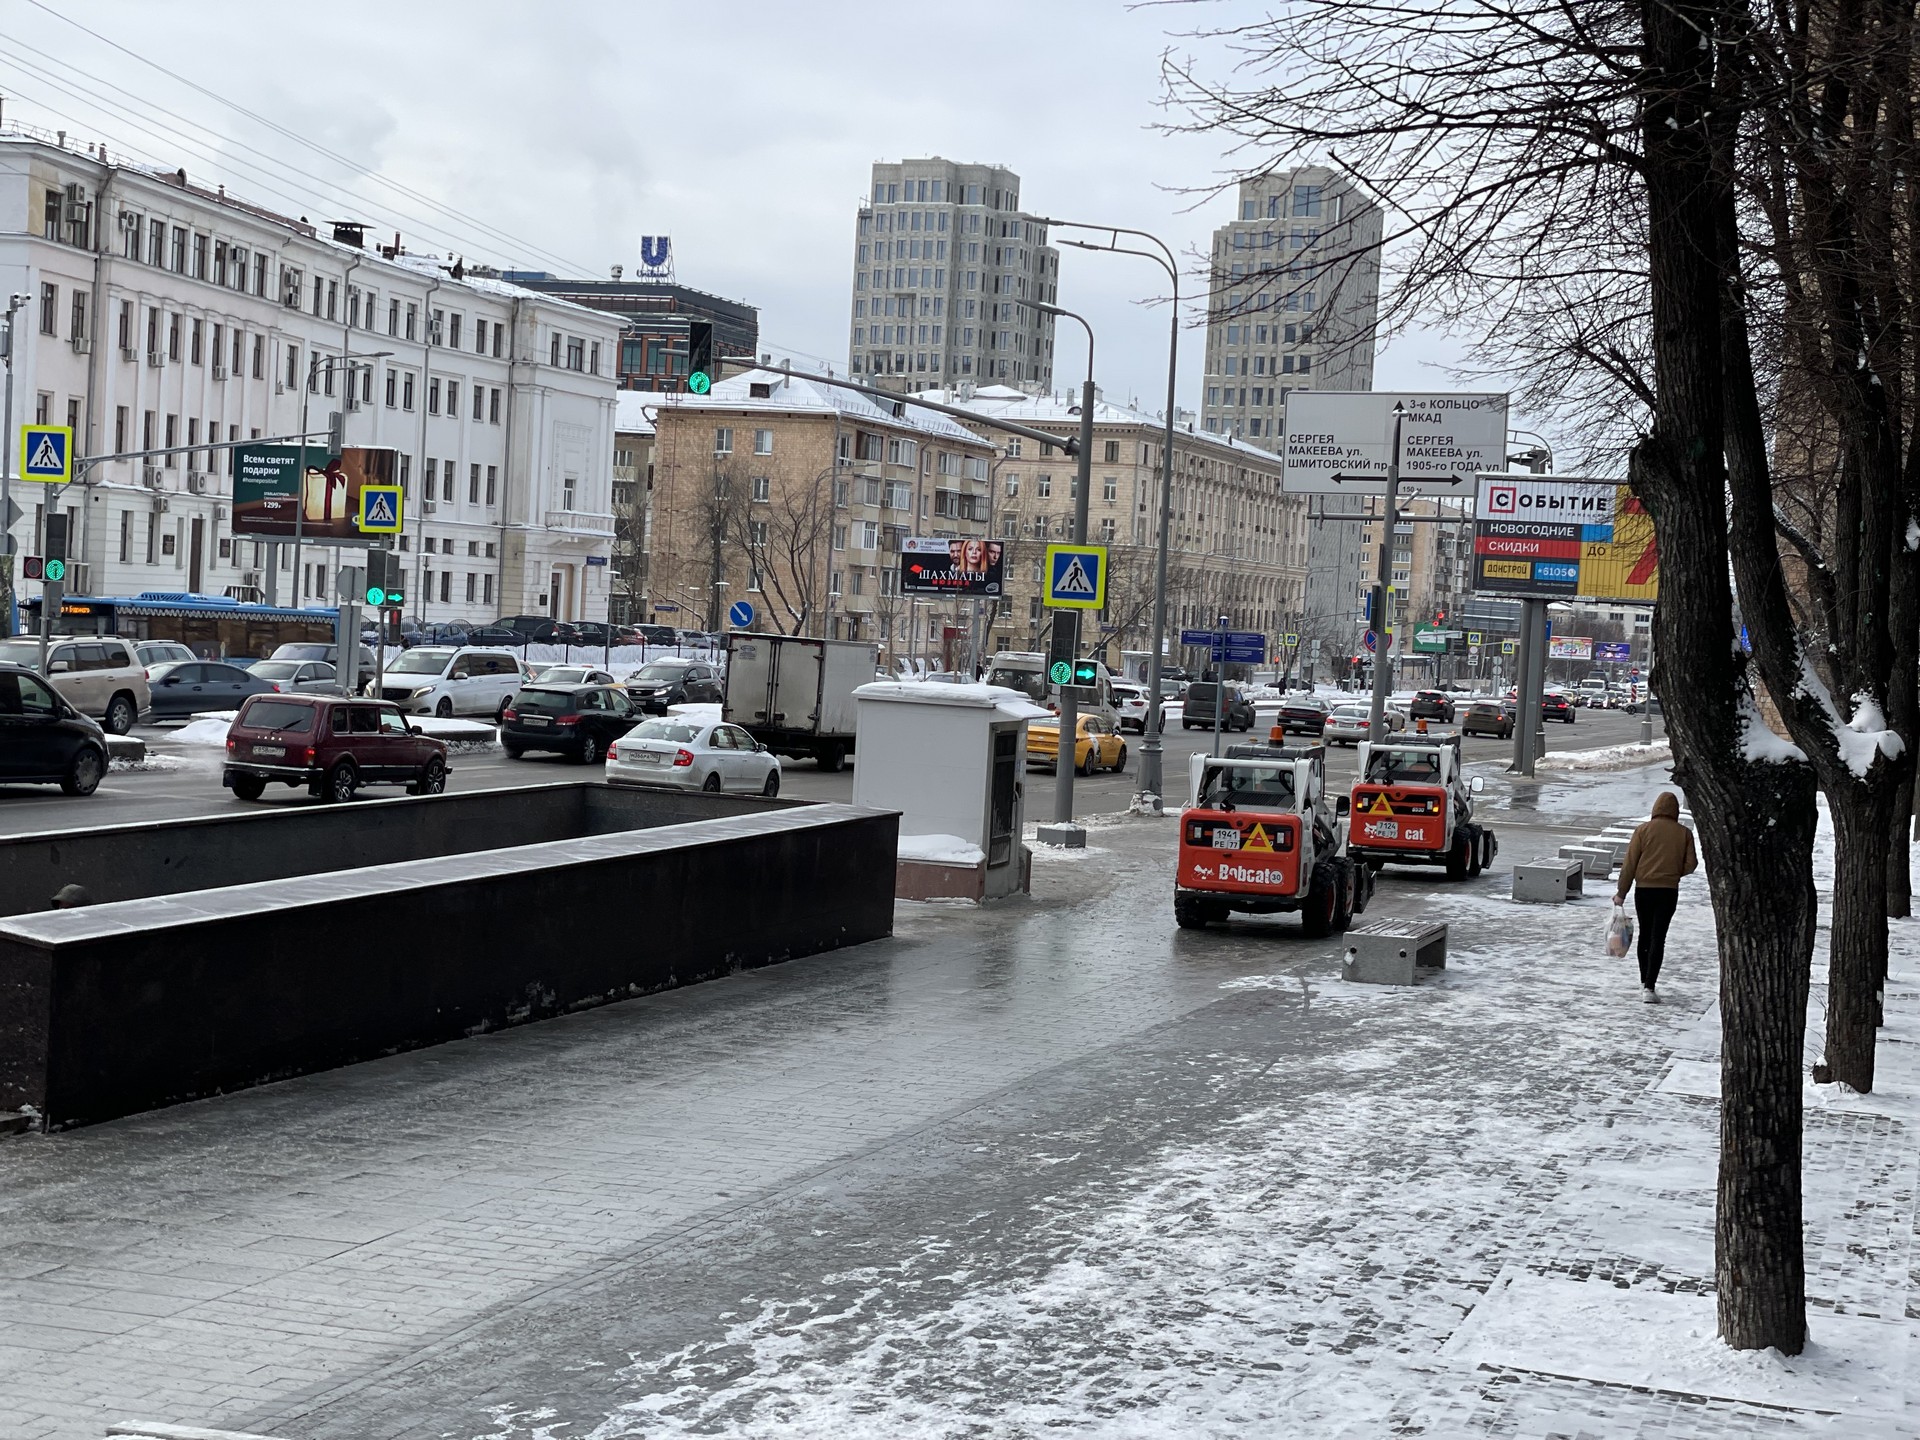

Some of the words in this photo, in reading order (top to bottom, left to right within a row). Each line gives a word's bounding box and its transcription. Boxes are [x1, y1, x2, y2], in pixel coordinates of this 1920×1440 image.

[641, 236, 668, 267] U
[1409, 400, 1426, 410] 3-е
[1430, 400, 1480, 411] КОЛЬЦО
[1408, 413, 1442, 424] МКАД
[1289, 434, 1335, 444] СЕРГЕЯ
[1407, 436, 1454, 446] СЕРГЕЯ
[1288, 446, 1343, 456] МАКЕЕВА
[1346, 449, 1363, 458] ул.
[1406, 448, 1463, 458] МАКЕЕВА
[1466, 450, 1484, 459] ул.
[243, 454, 265, 464] Всем
[266, 456, 295, 465] светят
[1288, 458, 1371, 470] ШМИТОВСКИЙ
[242, 466, 280, 476] подарки
[1406, 461, 1447, 471] 1905-го
[1450, 462, 1482, 472] ГОДА
[1486, 463, 1503, 473] ул.
[1496, 493, 1607, 511] СОБЫТИЕ
[1490, 523, 1575, 537] НОВОГОДНИЕ
[1488, 541, 1539, 553] СКИДКИ
[1587, 546, 1606, 557] ДО
[1487, 562, 1527, 575] ДОНСТРОЙ
[919, 569, 985, 581] ШАХМАТЫ
[1216, 830, 1238, 839] 1941
[1219, 864, 1270, 884] Bobcat
